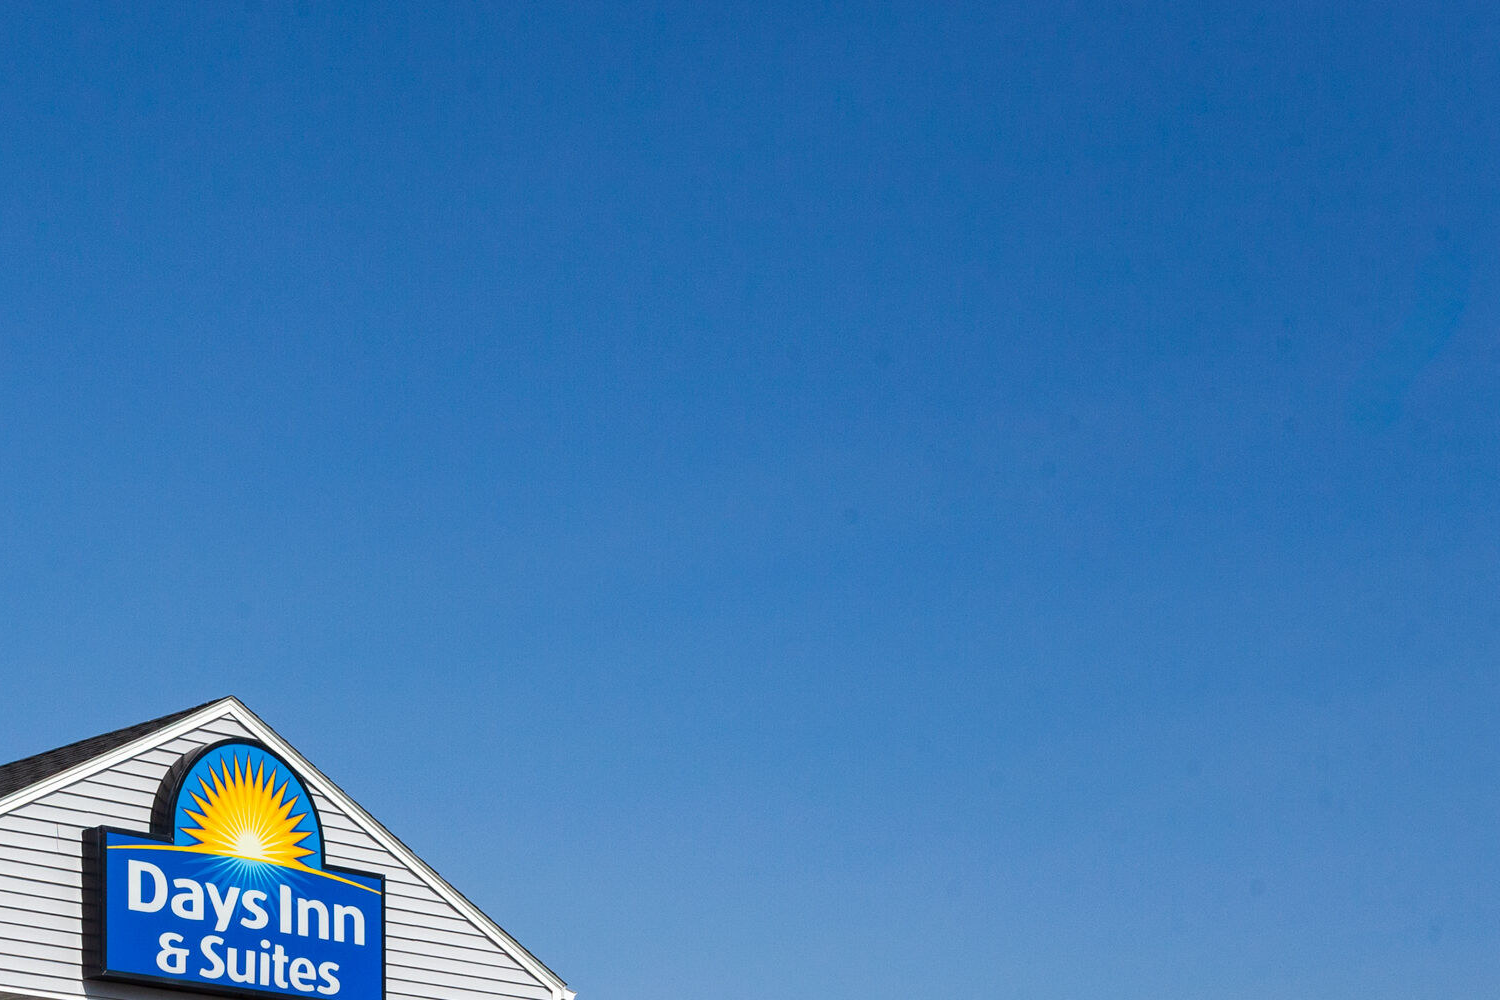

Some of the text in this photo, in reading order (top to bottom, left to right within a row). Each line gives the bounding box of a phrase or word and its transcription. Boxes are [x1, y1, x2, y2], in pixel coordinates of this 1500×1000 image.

[127, 859, 365, 946] Days Inn
[156, 932, 341, 995] & Suites
